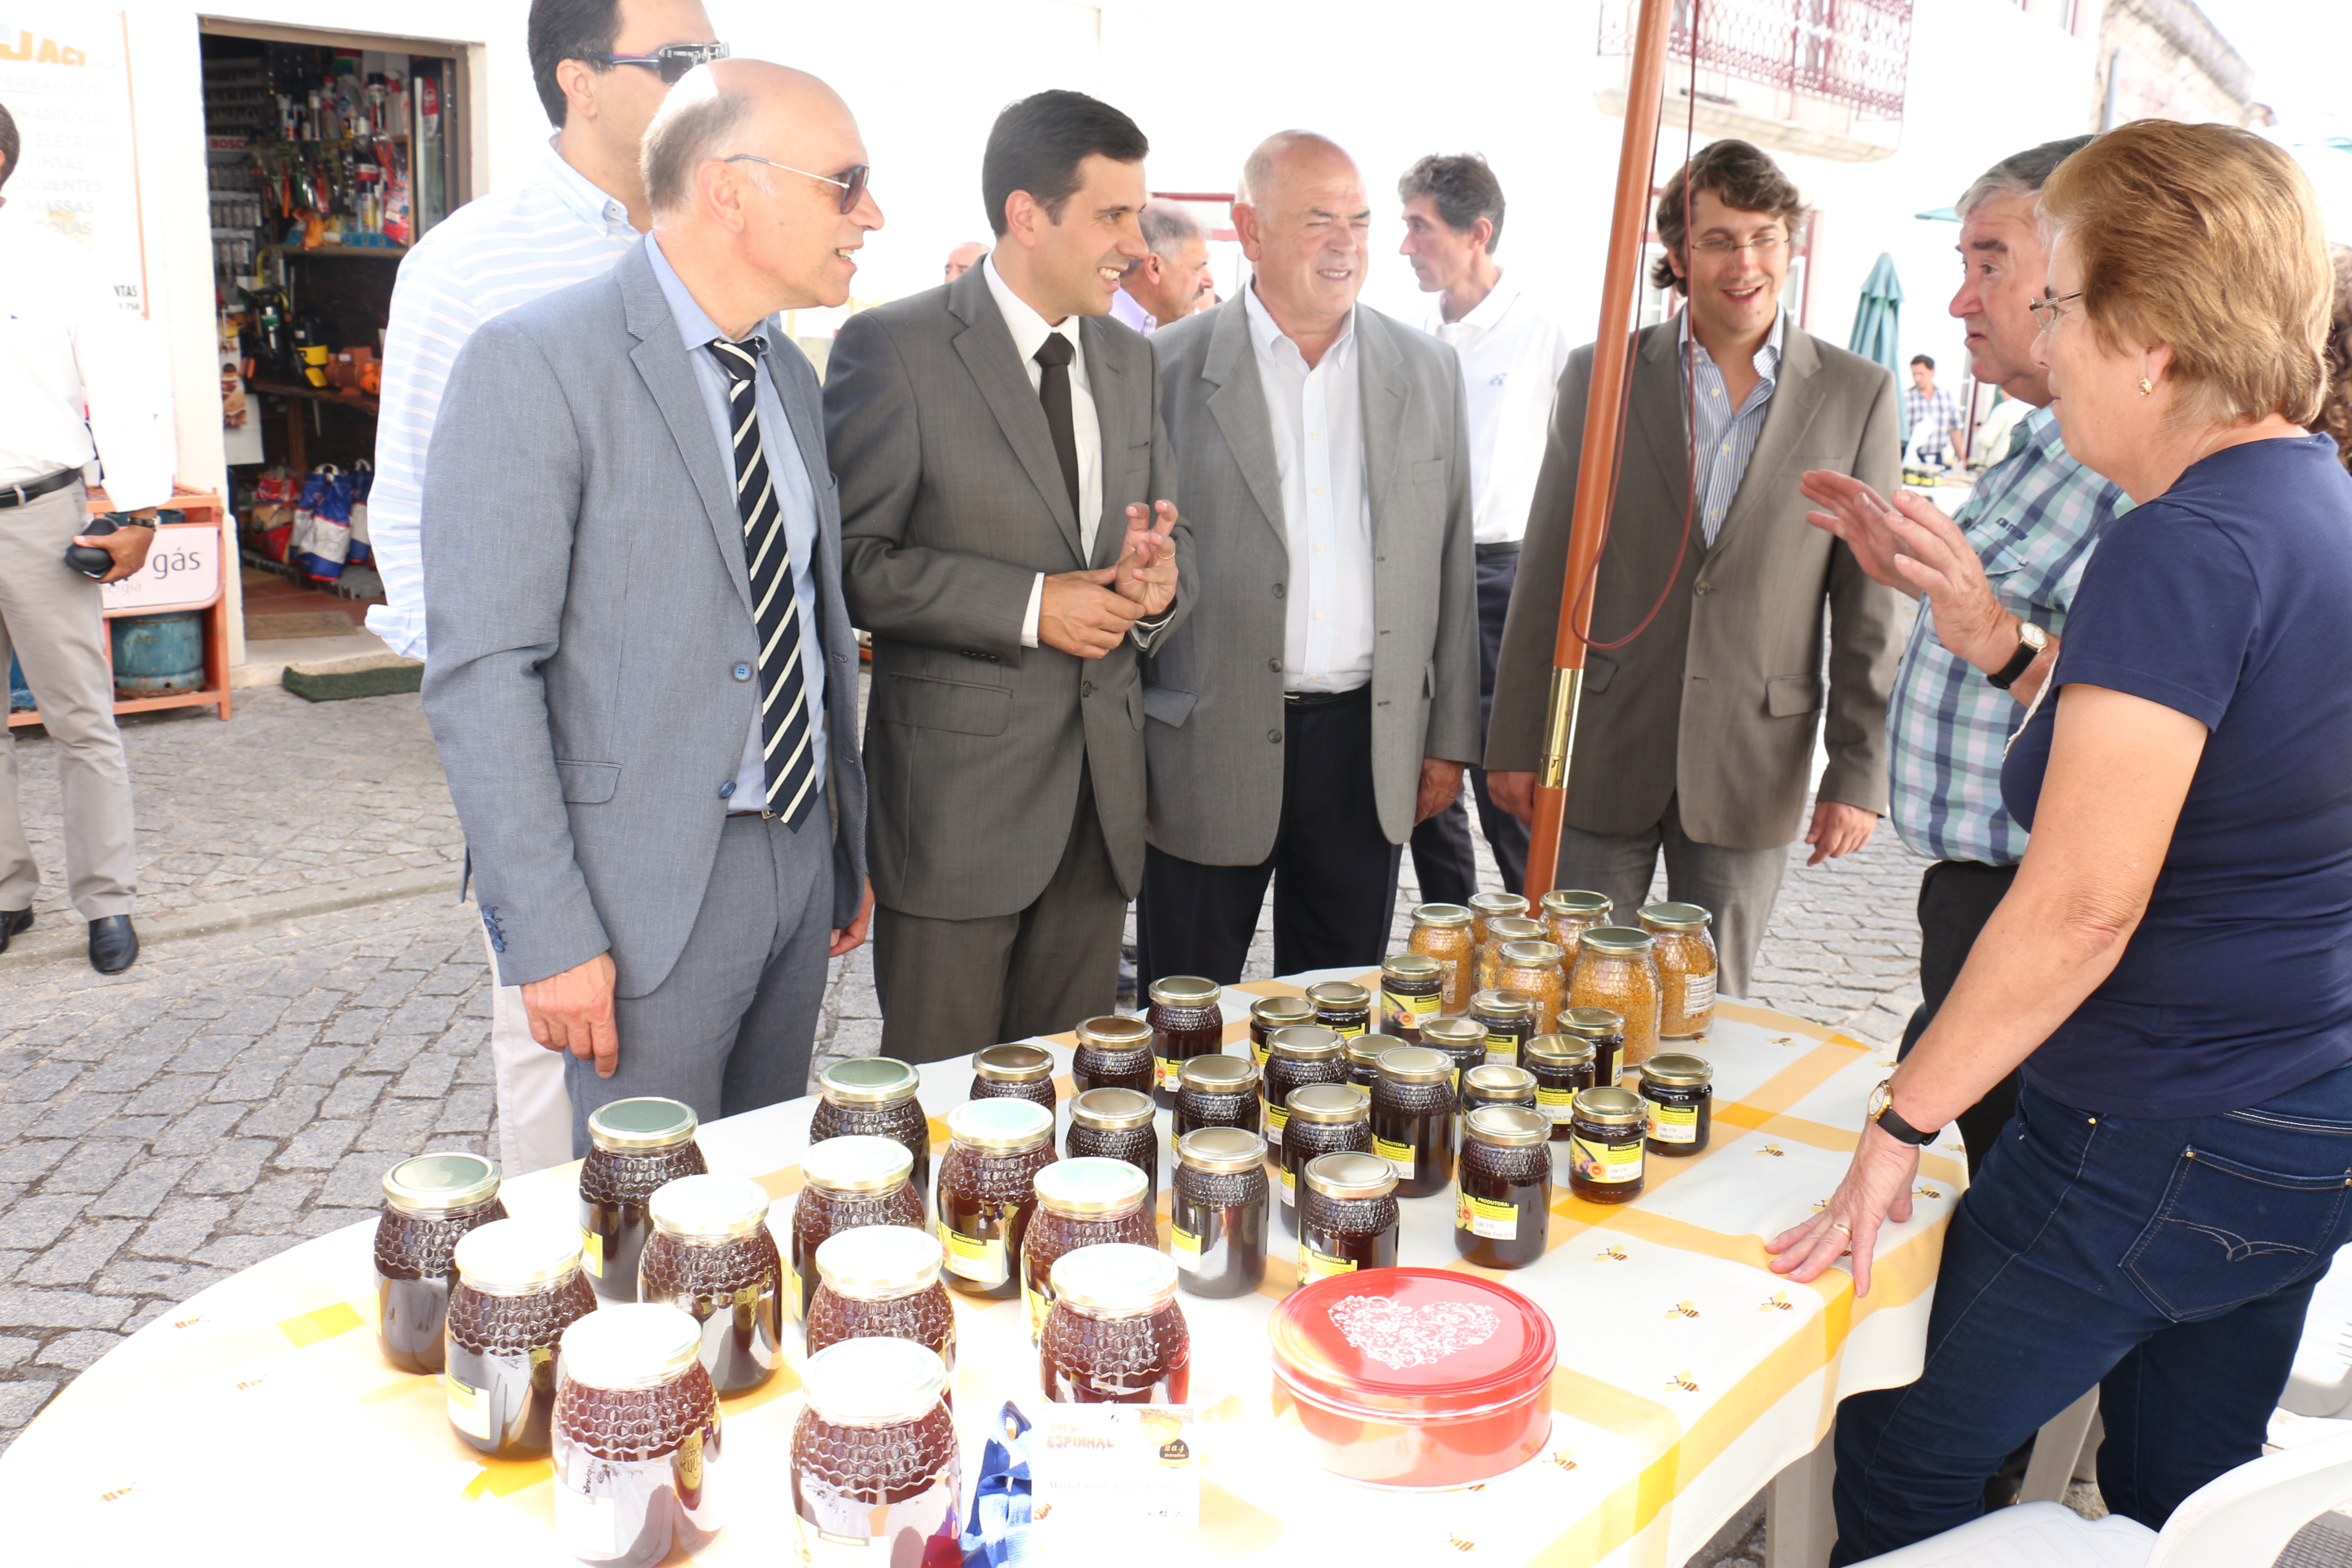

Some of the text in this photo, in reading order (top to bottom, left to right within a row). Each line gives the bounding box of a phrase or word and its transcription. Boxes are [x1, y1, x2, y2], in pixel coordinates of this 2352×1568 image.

[9, 105, 113, 125] RRAMENTAS
[28, 155, 85, 171] TINTAS
[14, 176, 103, 193] DILUENTES
[26, 199, 95, 214] MASSAS
[152, 547, 201, 579] gás
[102, 582, 142, 595] nergia
[1272, 1108, 1290, 1116] PRODUTO
[1380, 1138, 1407, 1148] PRODUTORA:
[1478, 1197, 1510, 1207] PRODUTORA:
[953, 1234, 983, 1245] PRODUTORA:
[1314, 1252, 1347, 1264] PRODUTORA:
[1047, 1436, 1115, 1450] ESPINHAL
[1178, 1445, 1184, 1453] 4
[1049, 1481, 1075, 1490] Maria
[1114, 1482, 1144, 1491] Duarte
[1147, 1482, 1183, 1491] Ferreira
